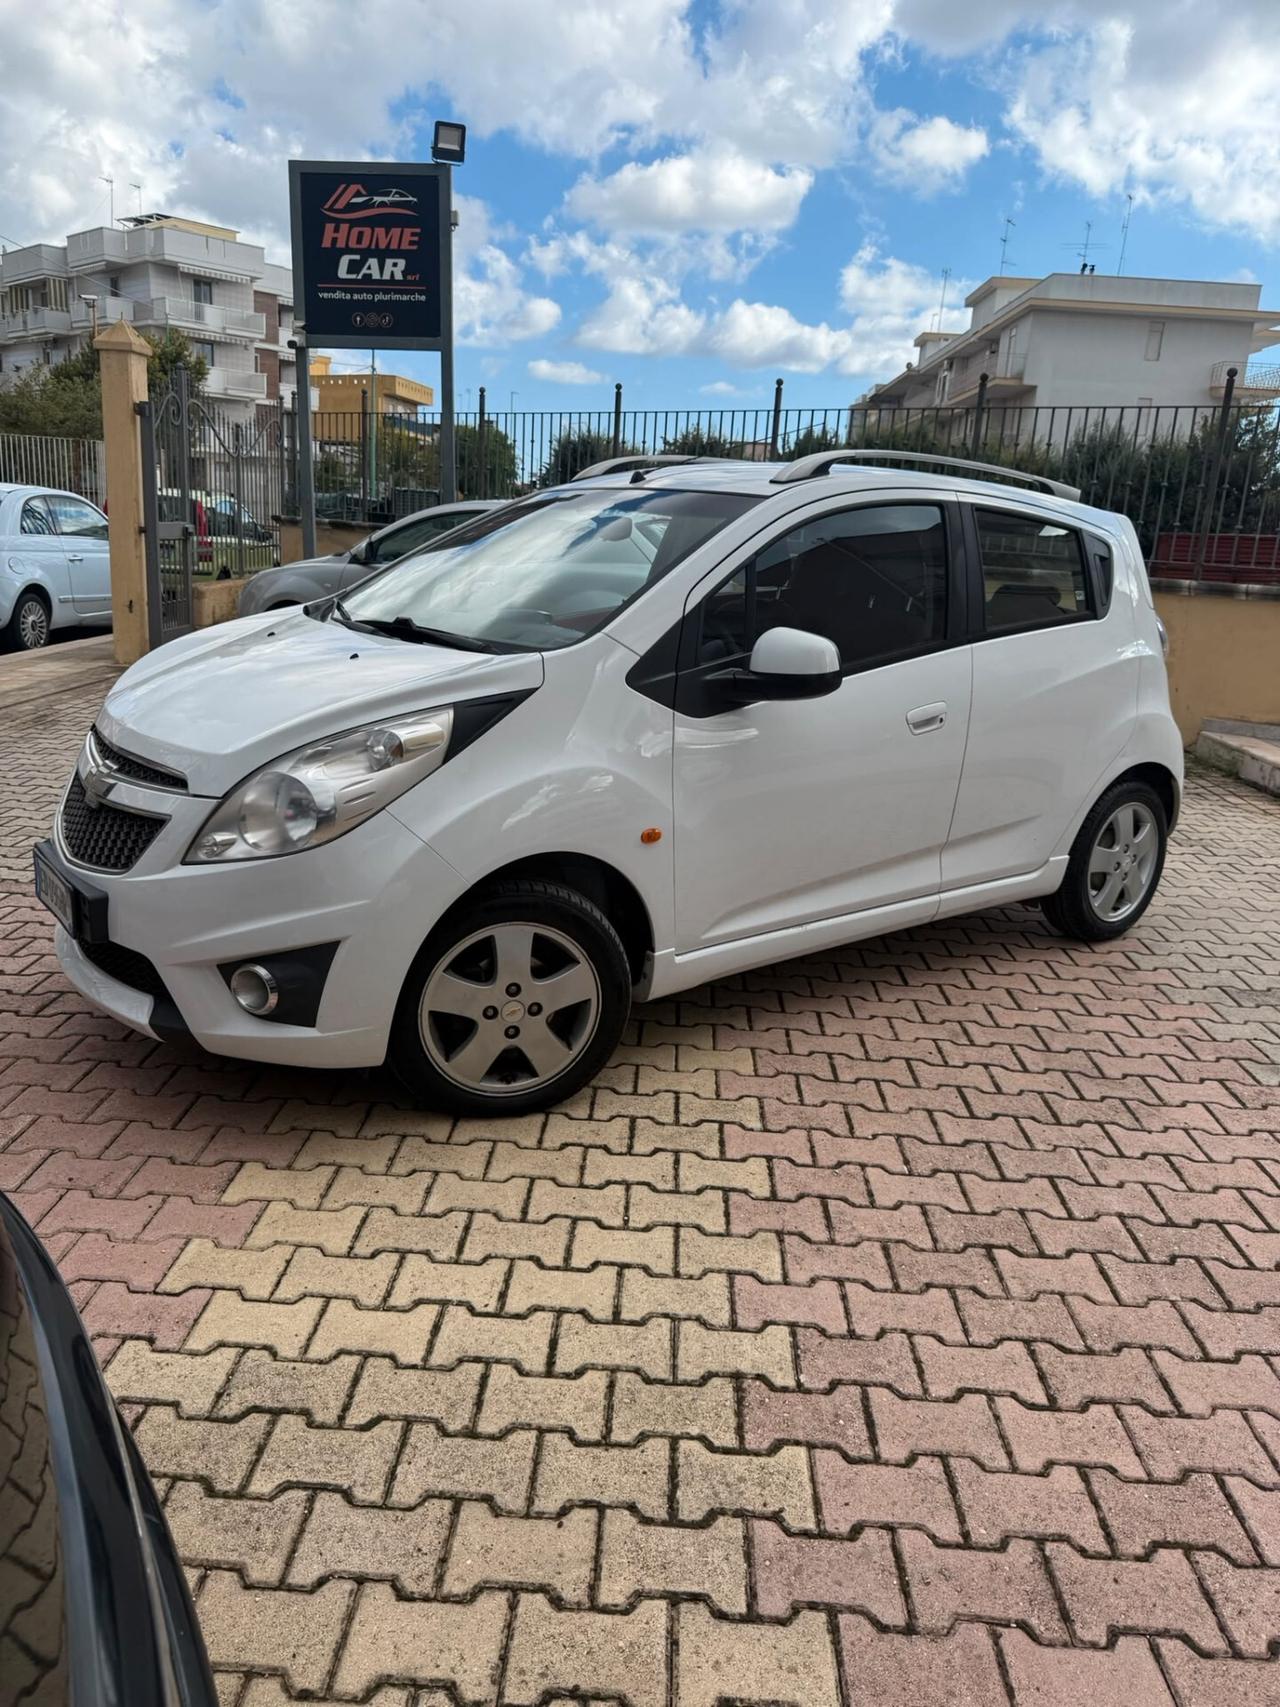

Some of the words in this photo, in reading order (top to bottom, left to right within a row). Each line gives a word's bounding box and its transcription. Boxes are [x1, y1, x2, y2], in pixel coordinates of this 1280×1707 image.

[321, 223, 421, 250] HOME
[337, 254, 406, 281] CAR
[318, 291, 351, 300] vendita
[352, 292, 373, 300] auto
[374, 291, 427, 302] plurimarche
